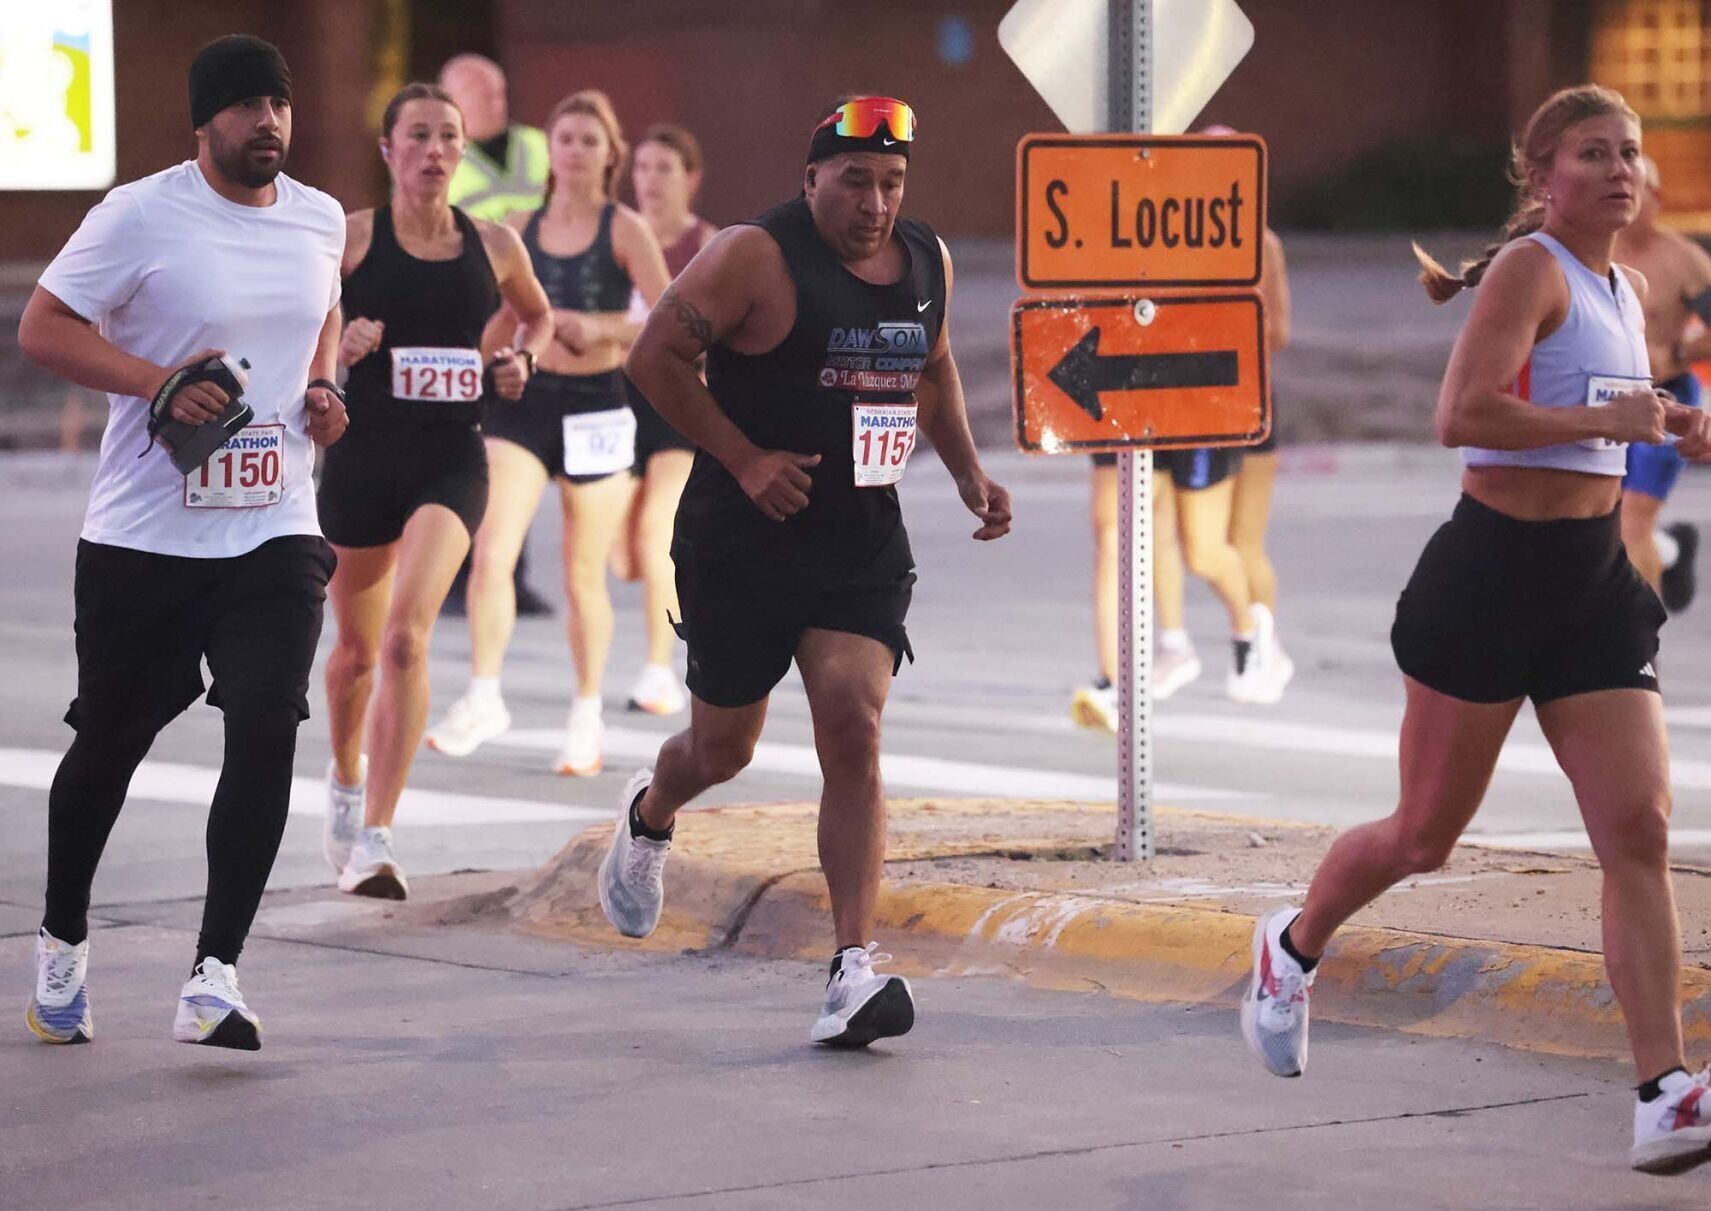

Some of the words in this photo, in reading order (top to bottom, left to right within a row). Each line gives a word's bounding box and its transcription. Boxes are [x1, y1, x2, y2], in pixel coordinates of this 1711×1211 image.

[1045, 180, 1084, 249] S.
[1110, 180, 1244, 250] Locust
[828, 326, 923, 353] DAWSON
[400, 355, 476, 367] MARATHON
[399, 366, 478, 398] 1219
[840, 370, 857, 386] La
[861, 416, 916, 428] MARATHO
[221, 436, 278, 449] RATHON
[200, 450, 279, 488] 1150
